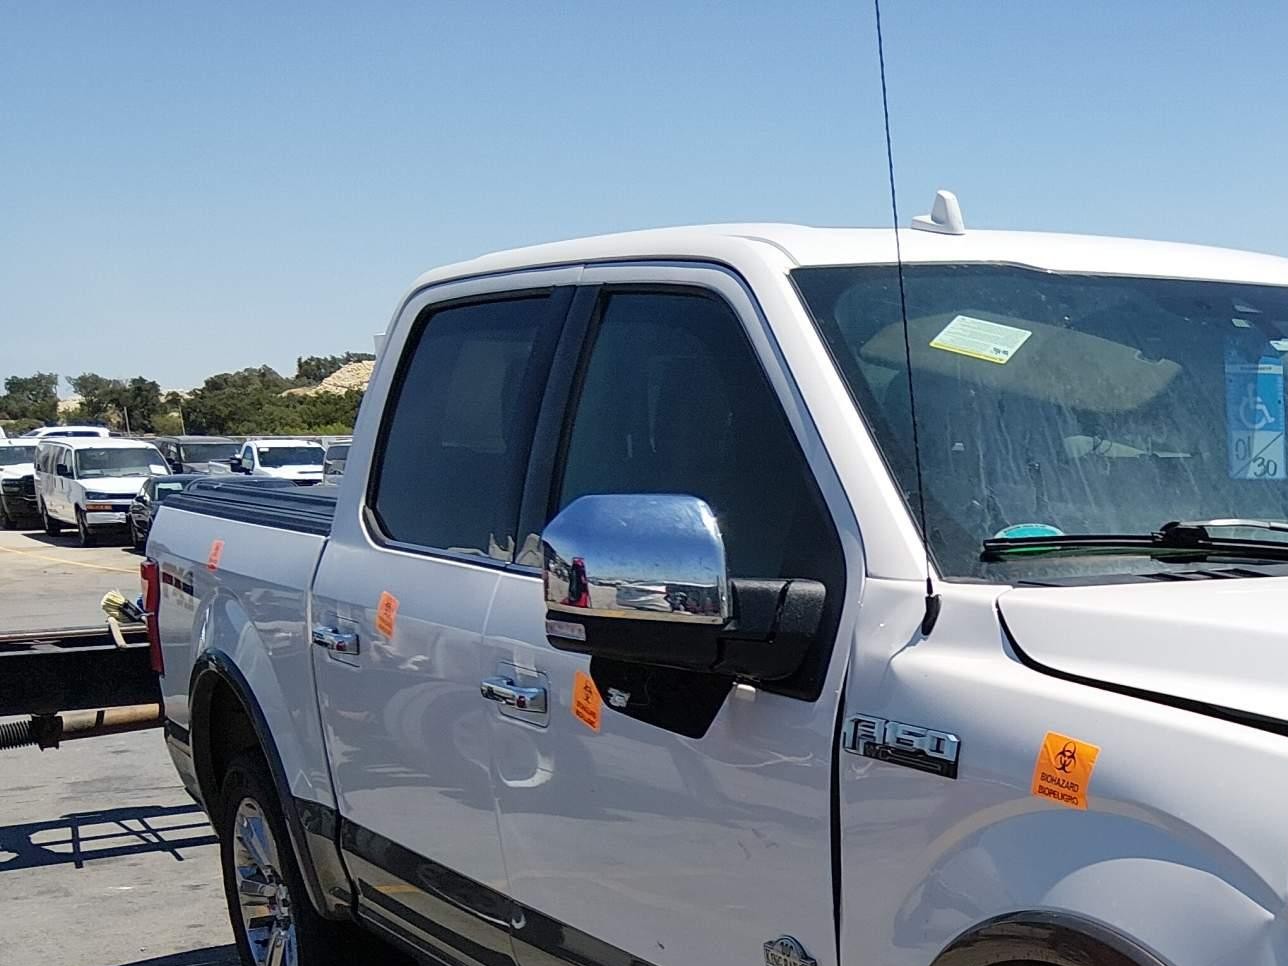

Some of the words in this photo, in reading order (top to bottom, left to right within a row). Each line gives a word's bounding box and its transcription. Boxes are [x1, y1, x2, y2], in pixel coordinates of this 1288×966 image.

[1253, 457, 1278, 478] 30
[1040, 772, 1080, 793] BIOHAZARD
[1037, 785, 1079, 806] BIOPELIGRO
